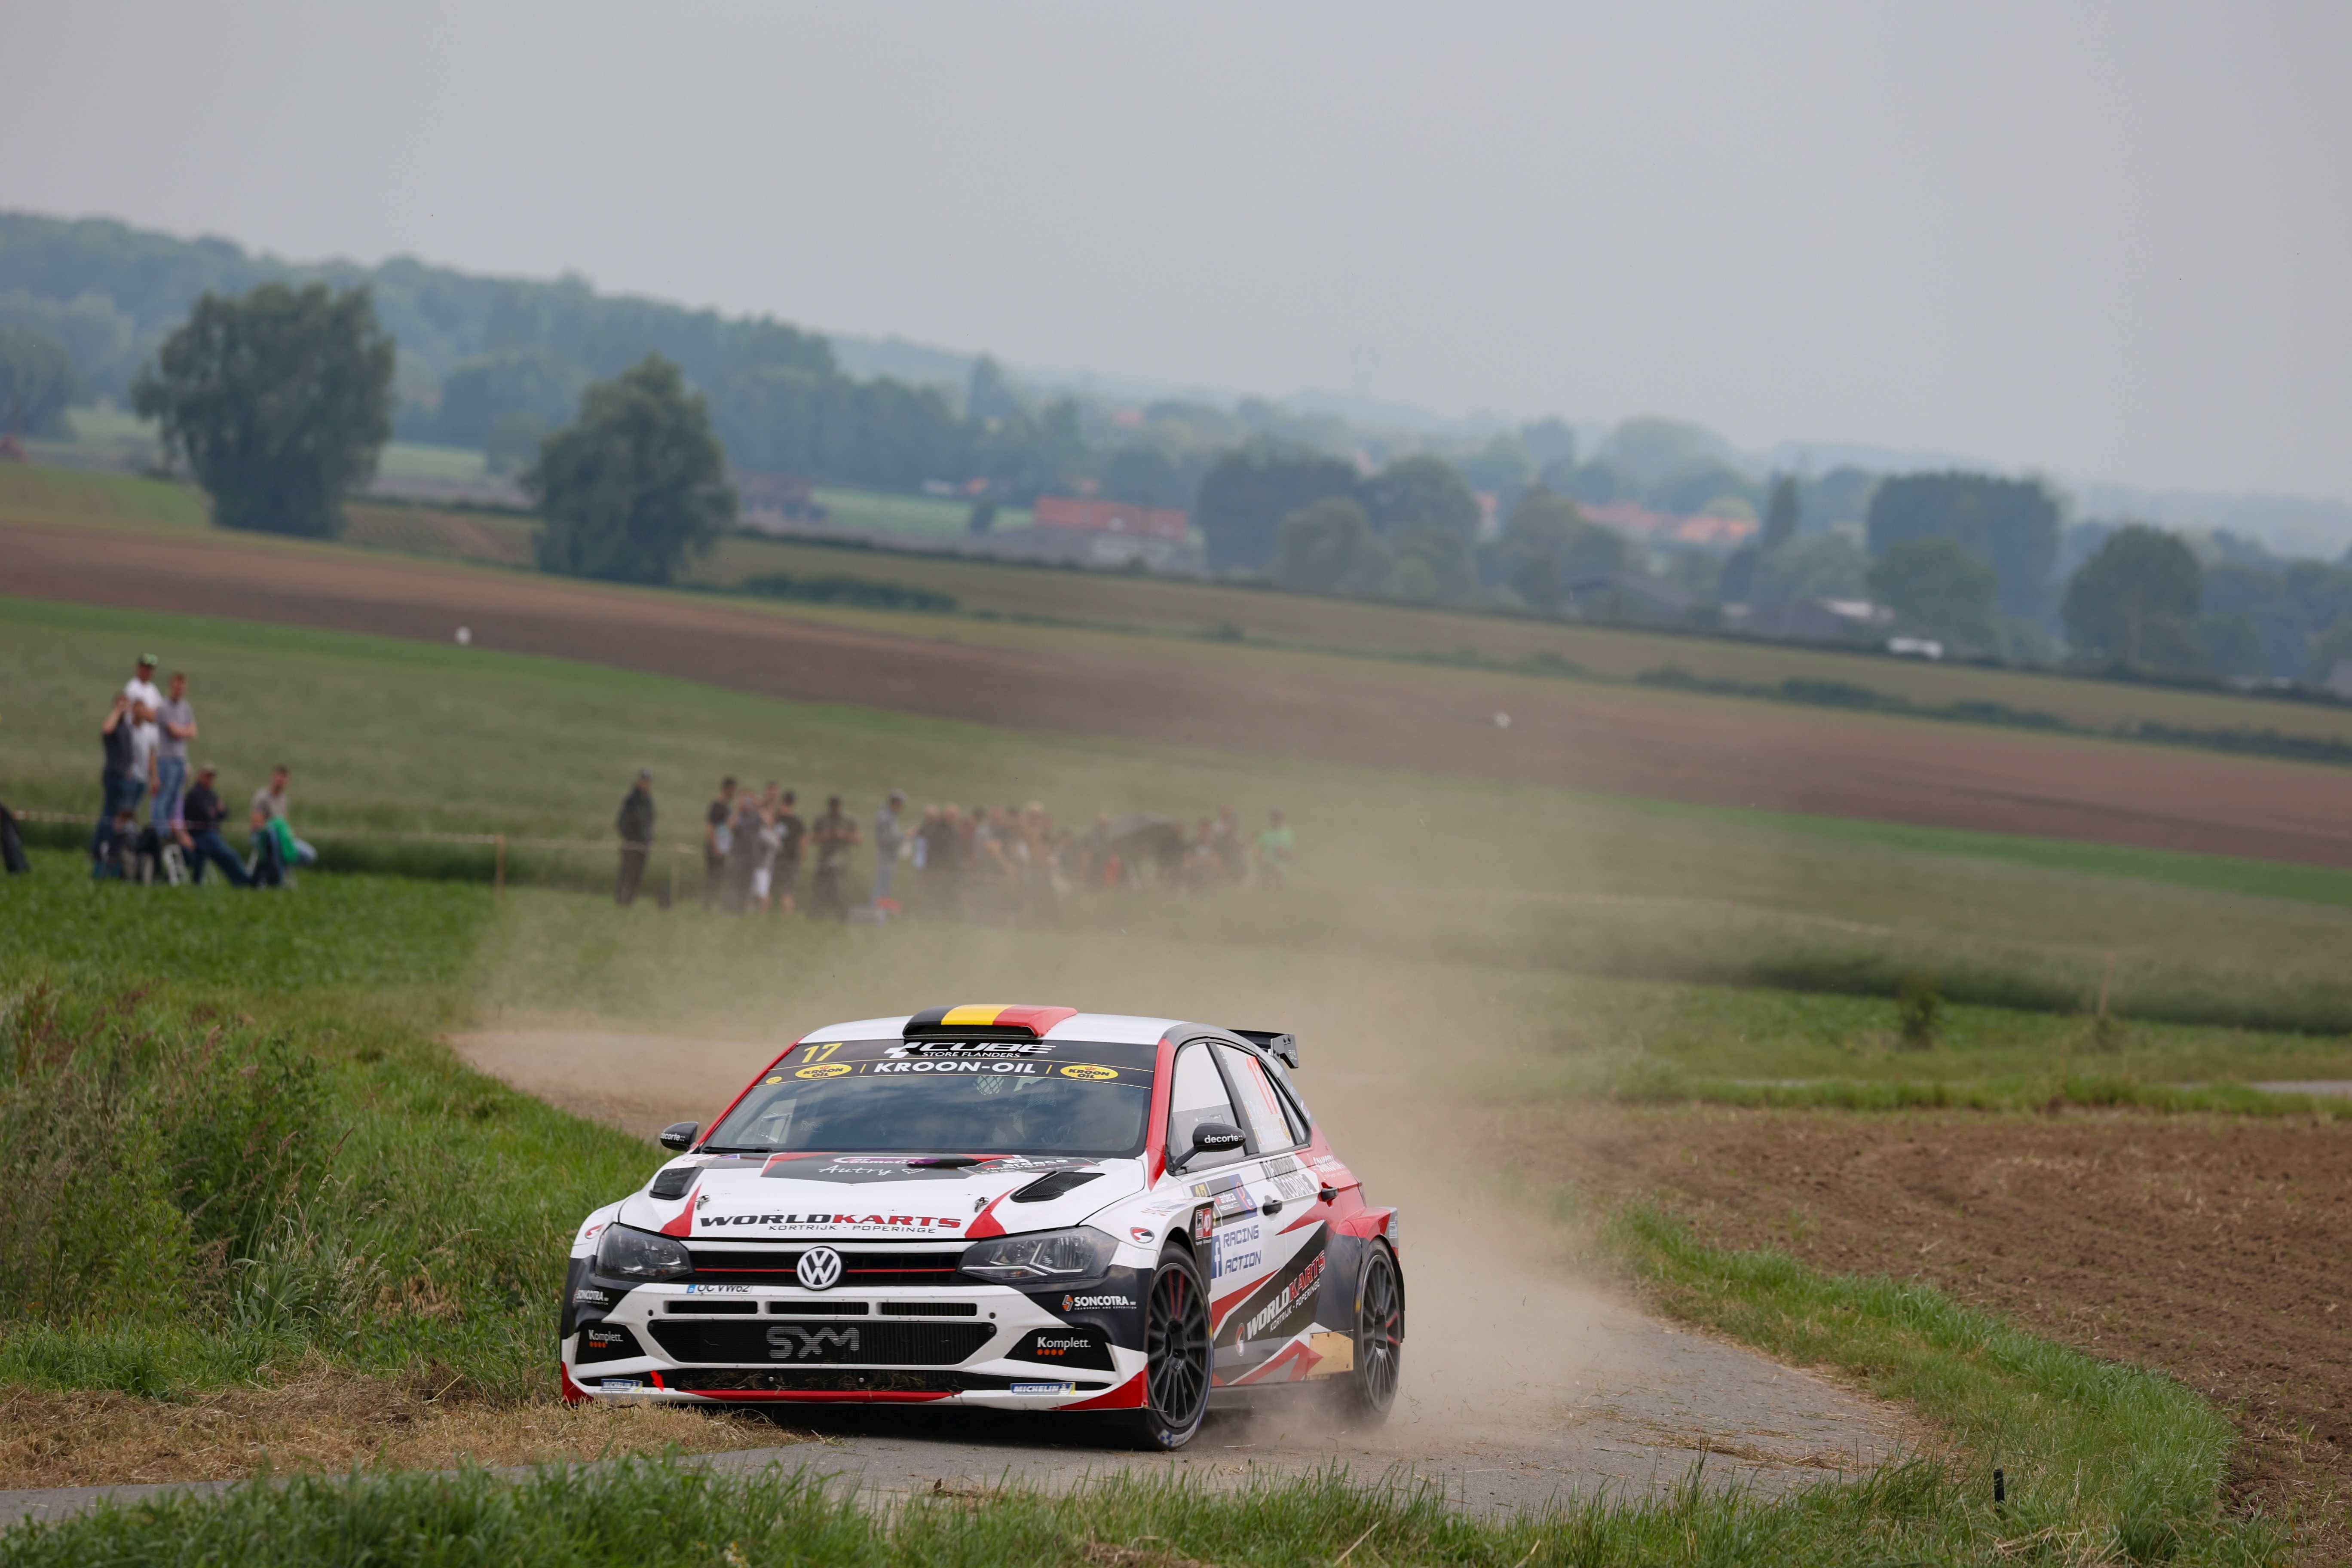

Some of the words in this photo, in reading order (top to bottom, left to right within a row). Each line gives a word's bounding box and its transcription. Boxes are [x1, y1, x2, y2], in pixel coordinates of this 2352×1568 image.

[802, 1043, 842, 1063] 17
[919, 1042, 1056, 1054] CUBE
[874, 1061, 1036, 1073] KROON-OIL
[818, 1164, 895, 1176] Autry
[699, 1214, 962, 1228] WORLDKARTS
[853, 1225, 936, 1234] POPERINGE
[1223, 1225, 1259, 1248] RACING
[1225, 1250, 1262, 1275] ACTION
[1074, 1295, 1130, 1307] SONCOTRA
[1246, 1250, 1326, 1341] WORLDKARTS
[766, 1326, 859, 1358] SXM
[1013, 1385, 1060, 1393] MICHELIN
